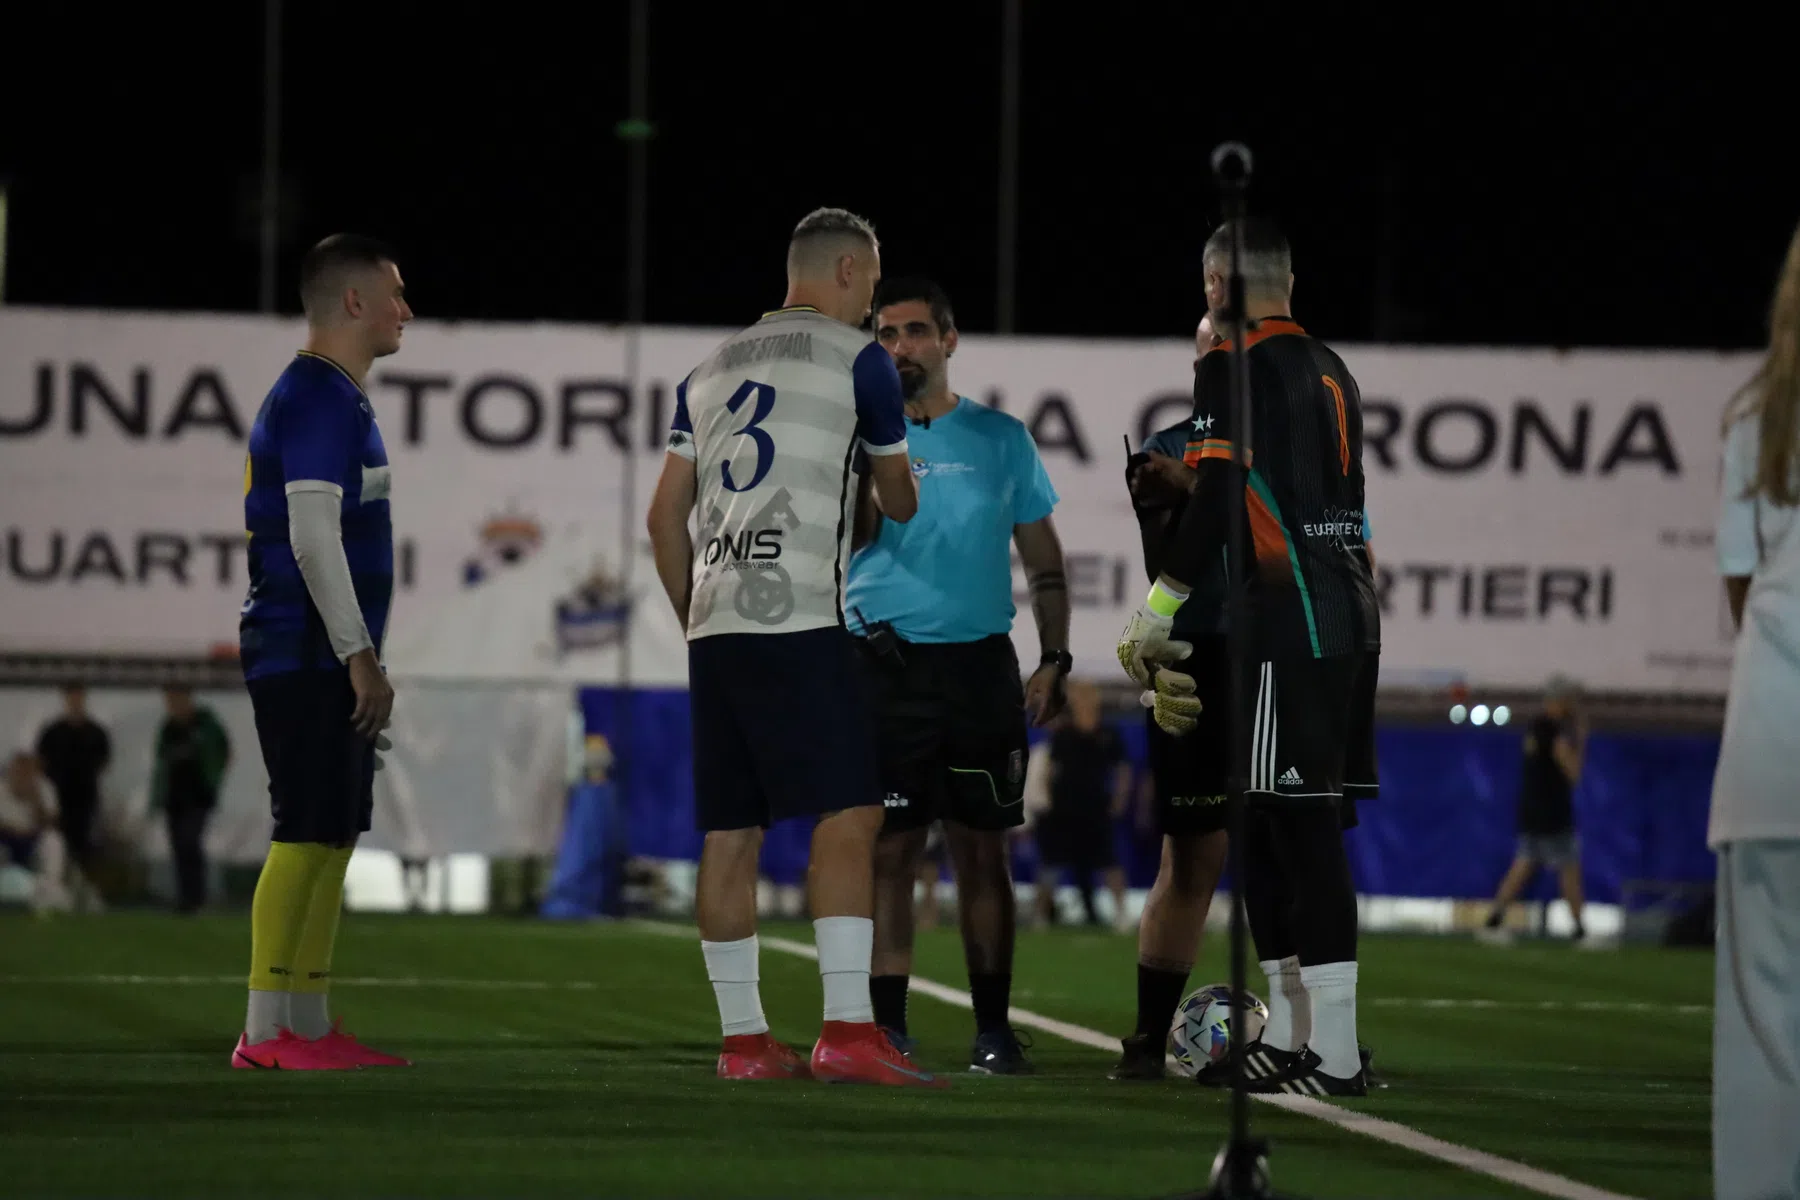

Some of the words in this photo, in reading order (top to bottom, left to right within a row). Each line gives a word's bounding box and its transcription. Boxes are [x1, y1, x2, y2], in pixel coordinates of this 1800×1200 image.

[378, 372, 666, 450] TORI
[1137, 390, 1682, 477] CRONA
[721, 378, 776, 492] 3
[1321, 374, 1350, 477] 1
[0, 528, 414, 588] UARTI
[1376, 563, 1615, 620] TIERI
[704, 529, 783, 567] ONIS
[1277, 777, 1304, 785] adidas
